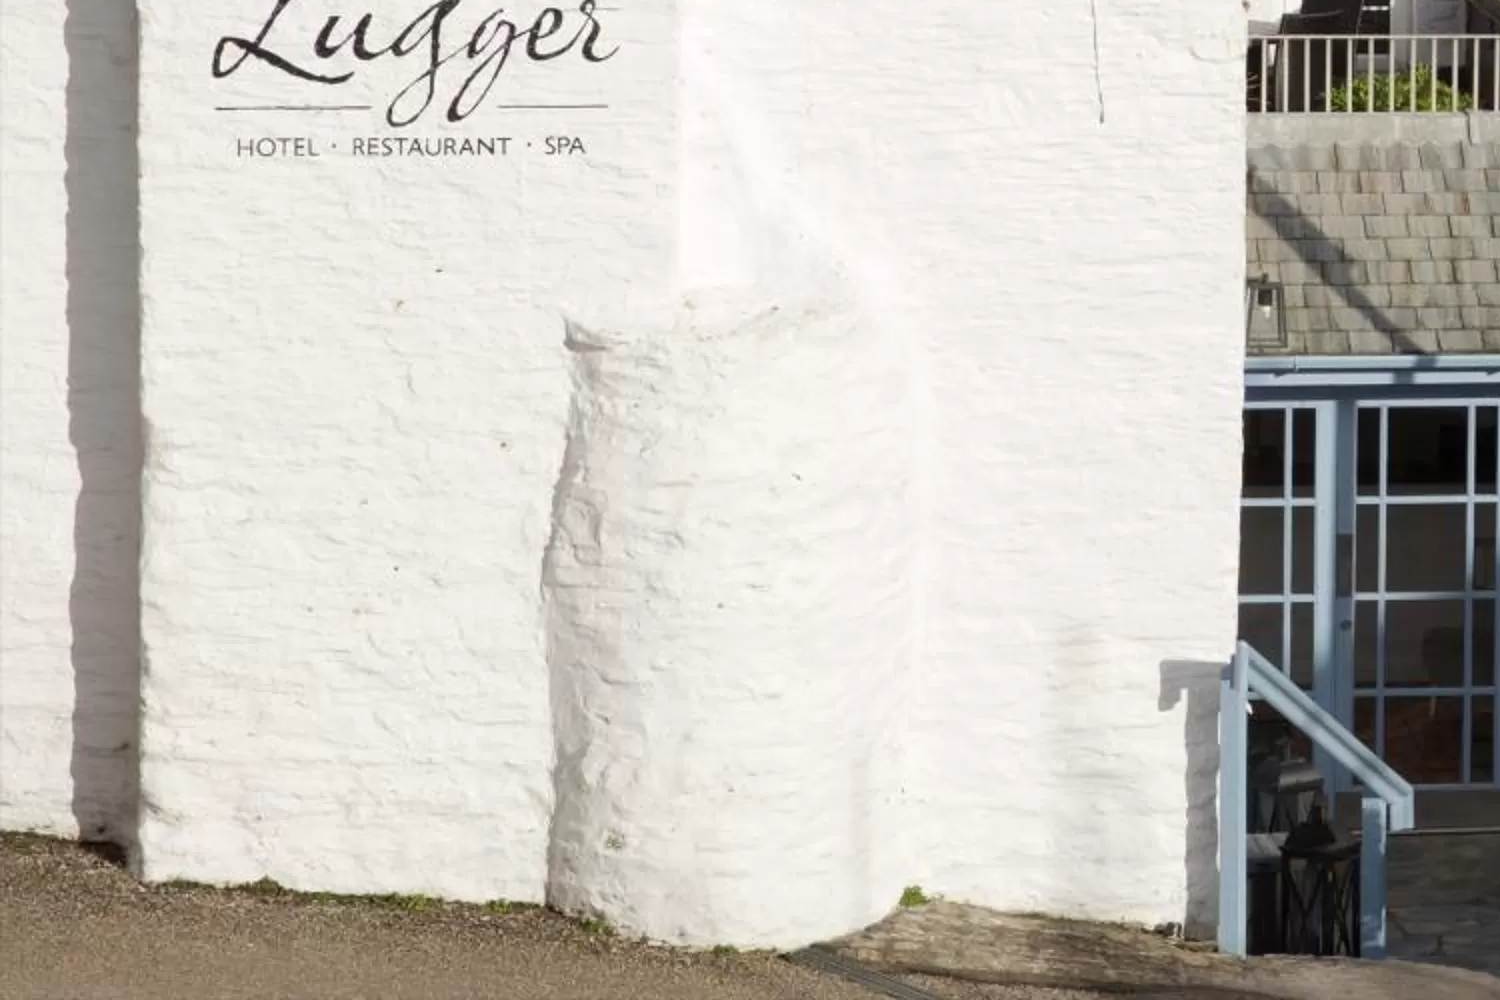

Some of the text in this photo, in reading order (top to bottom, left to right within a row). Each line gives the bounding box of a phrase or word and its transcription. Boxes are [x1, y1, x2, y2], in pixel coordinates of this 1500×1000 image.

[236, 135, 586, 157] HOTEL RESTAURANT SPA
